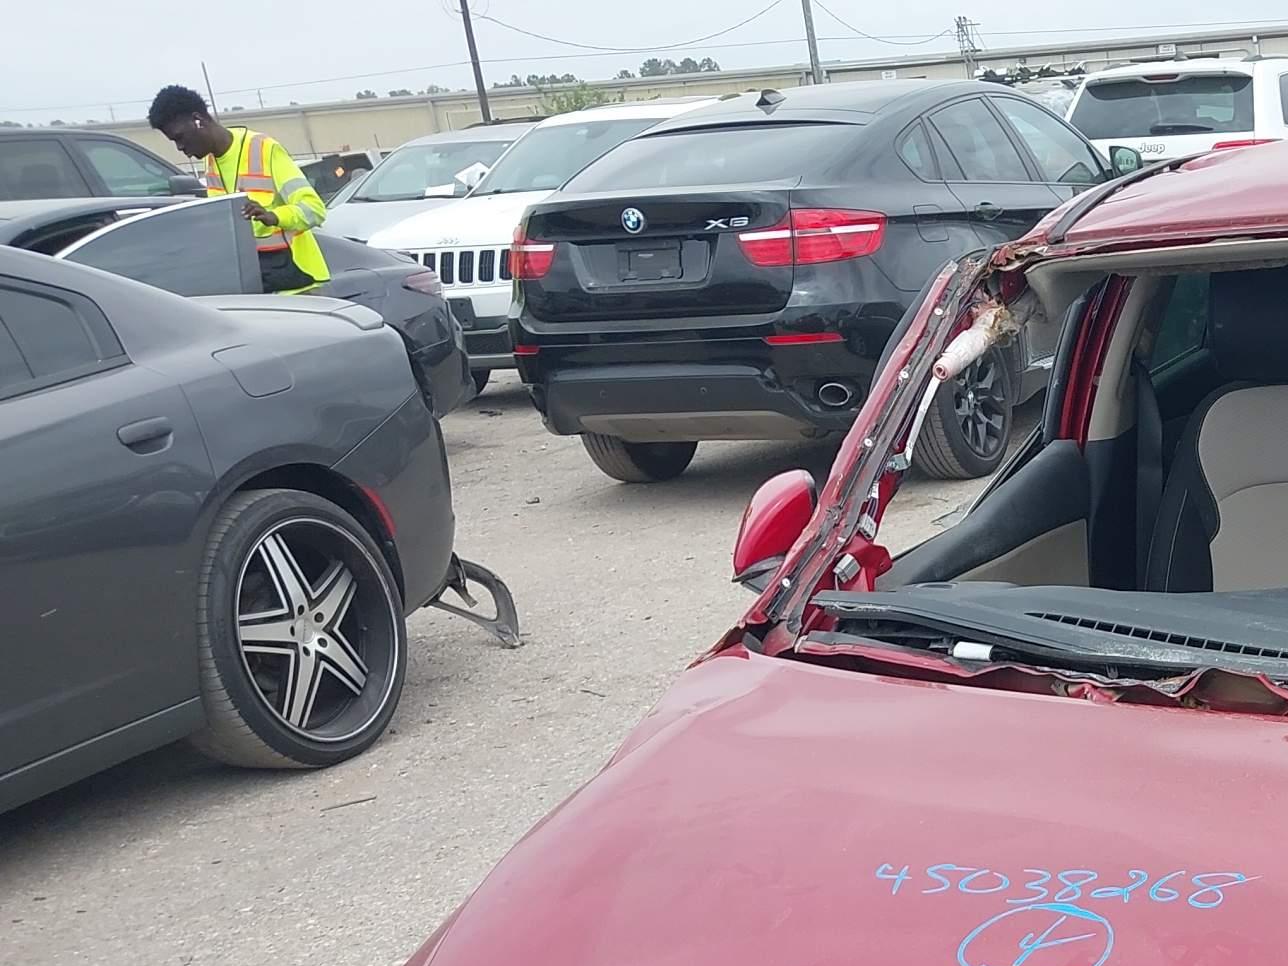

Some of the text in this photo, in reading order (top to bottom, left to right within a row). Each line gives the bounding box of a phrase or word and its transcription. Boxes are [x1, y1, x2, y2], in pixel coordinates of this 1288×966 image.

[1138, 142, 1165, 154] Jeep
[704, 216, 749, 231] X6
[876, 863, 1263, 908] 45038268
